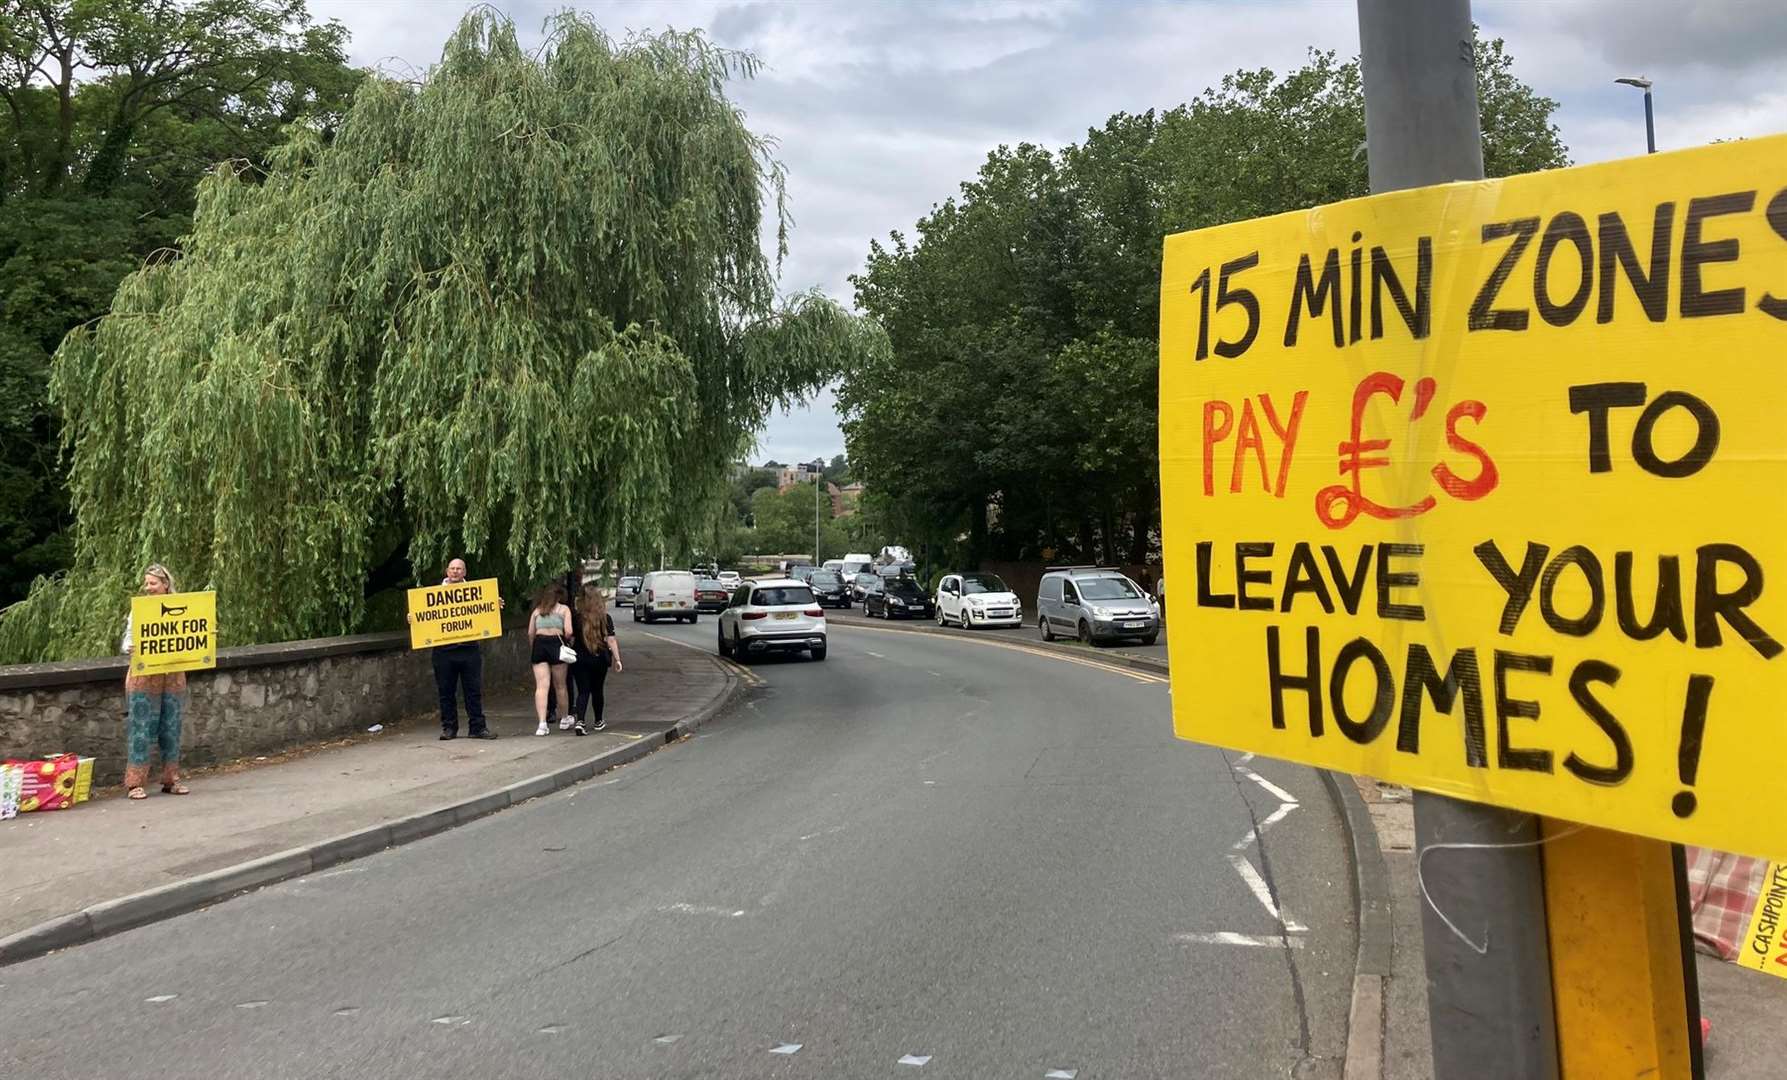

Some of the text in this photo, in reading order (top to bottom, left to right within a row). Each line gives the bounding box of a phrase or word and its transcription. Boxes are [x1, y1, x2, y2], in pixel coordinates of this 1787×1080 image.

[1190, 251, 1261, 362] 15
[1203, 390, 1309, 498] PAY
[1568, 382, 1721, 478] TO
[426, 586, 483, 607] DANGER!
[1196, 539, 1785, 660] LEAVE YOUR
[415, 602, 496, 622] WORLD ECONOMIC
[141, 618, 208, 638] HONK FOR
[441, 619, 473, 633] FORUM
[140, 635, 208, 656] FREEDOM
